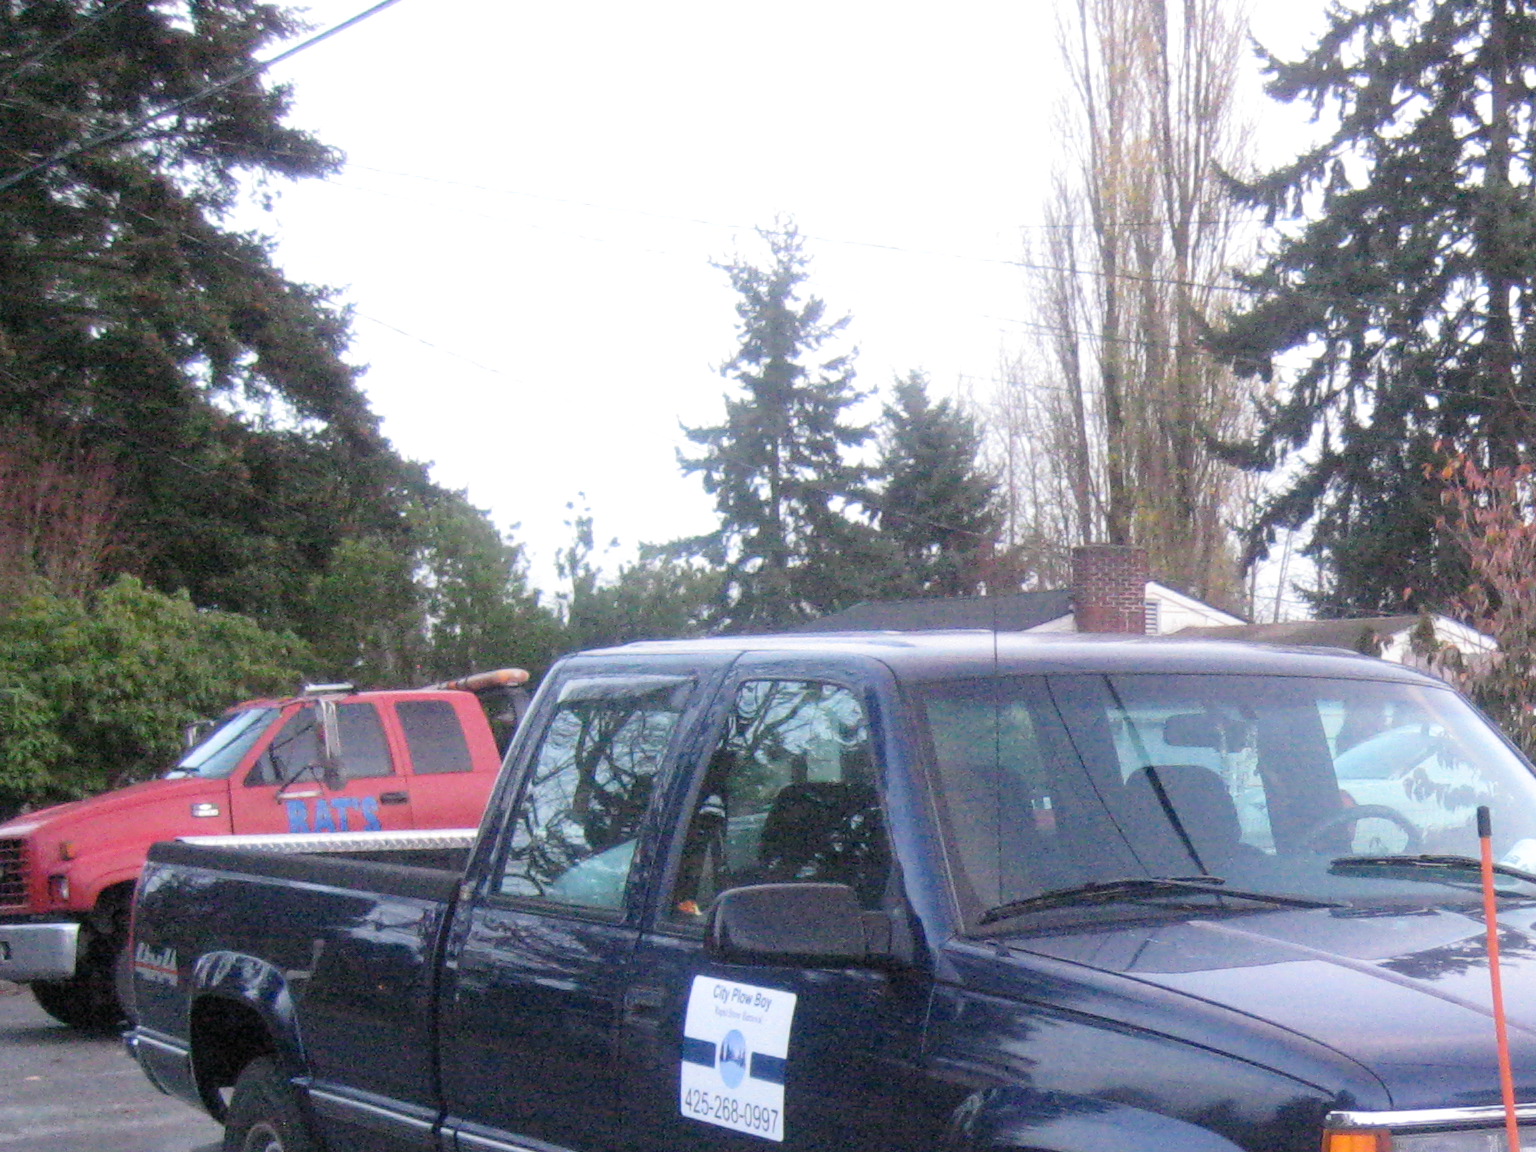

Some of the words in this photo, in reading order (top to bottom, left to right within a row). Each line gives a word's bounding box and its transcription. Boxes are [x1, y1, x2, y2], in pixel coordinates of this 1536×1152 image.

[713, 984, 730, 1004] City
[731, 987, 753, 1005] Plow
[754, 992, 772, 1012] Boy
[685, 1088, 778, 1133] 425-268-0997
